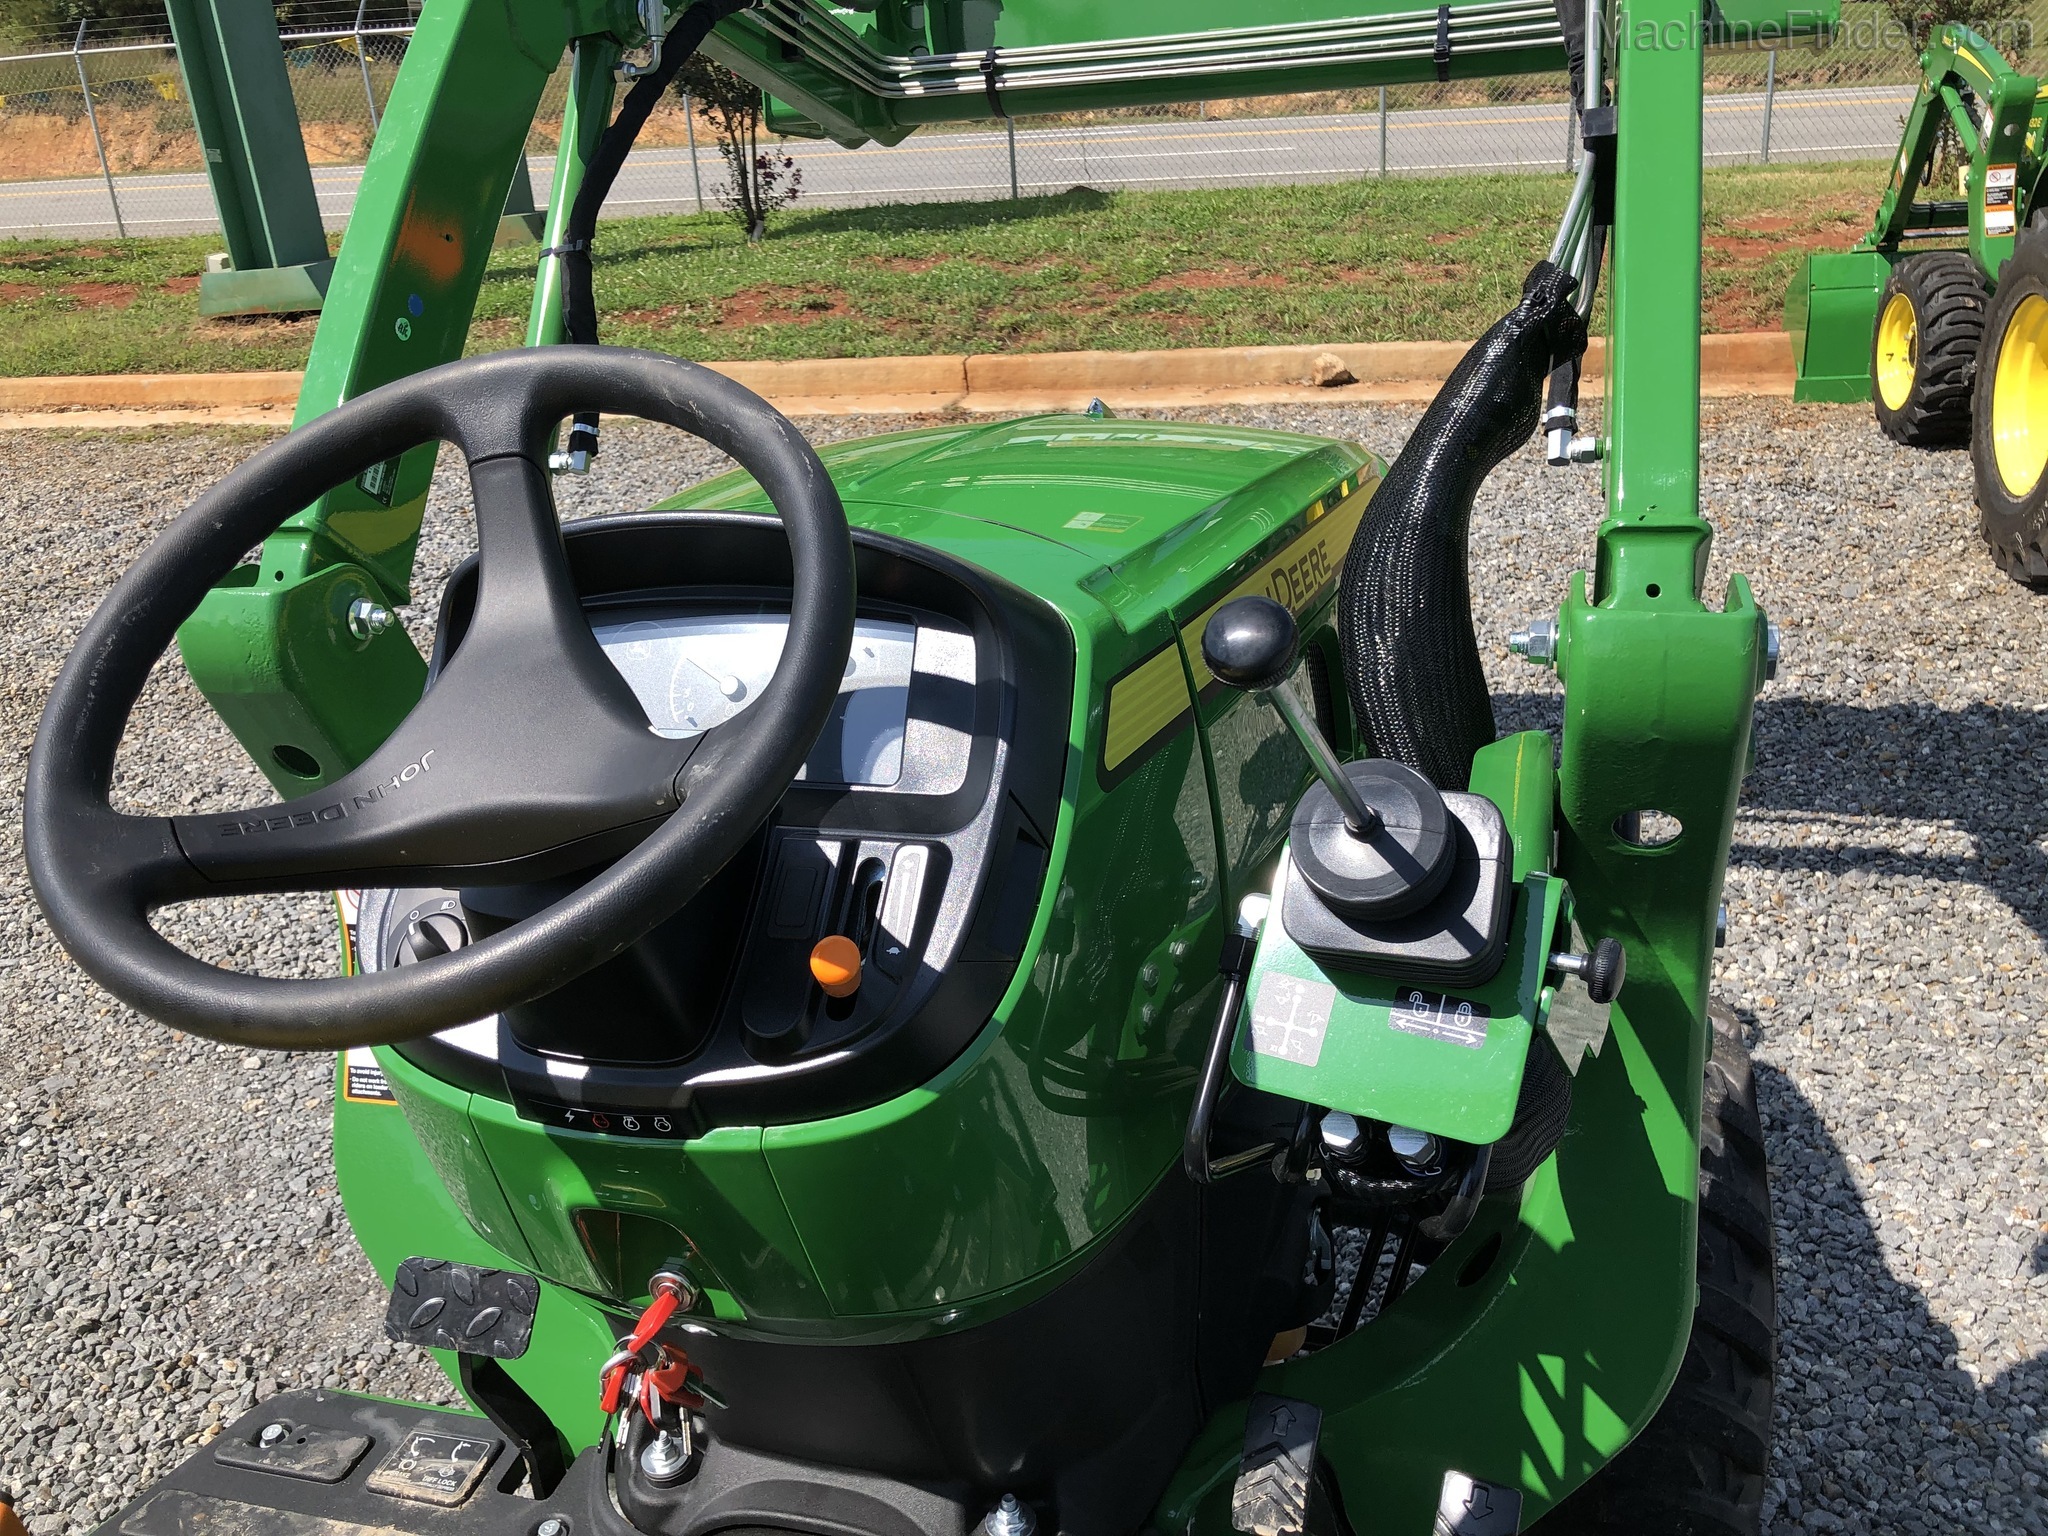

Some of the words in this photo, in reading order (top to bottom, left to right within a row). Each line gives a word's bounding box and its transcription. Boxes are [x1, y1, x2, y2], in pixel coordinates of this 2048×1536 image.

[1270, 539, 1331, 611] DEERE
[352, 749, 435, 810] JOHN
[217, 802, 349, 838] DEERE
[421, 1475, 438, 1483] DIFF
[438, 1478, 457, 1487] LOCK
